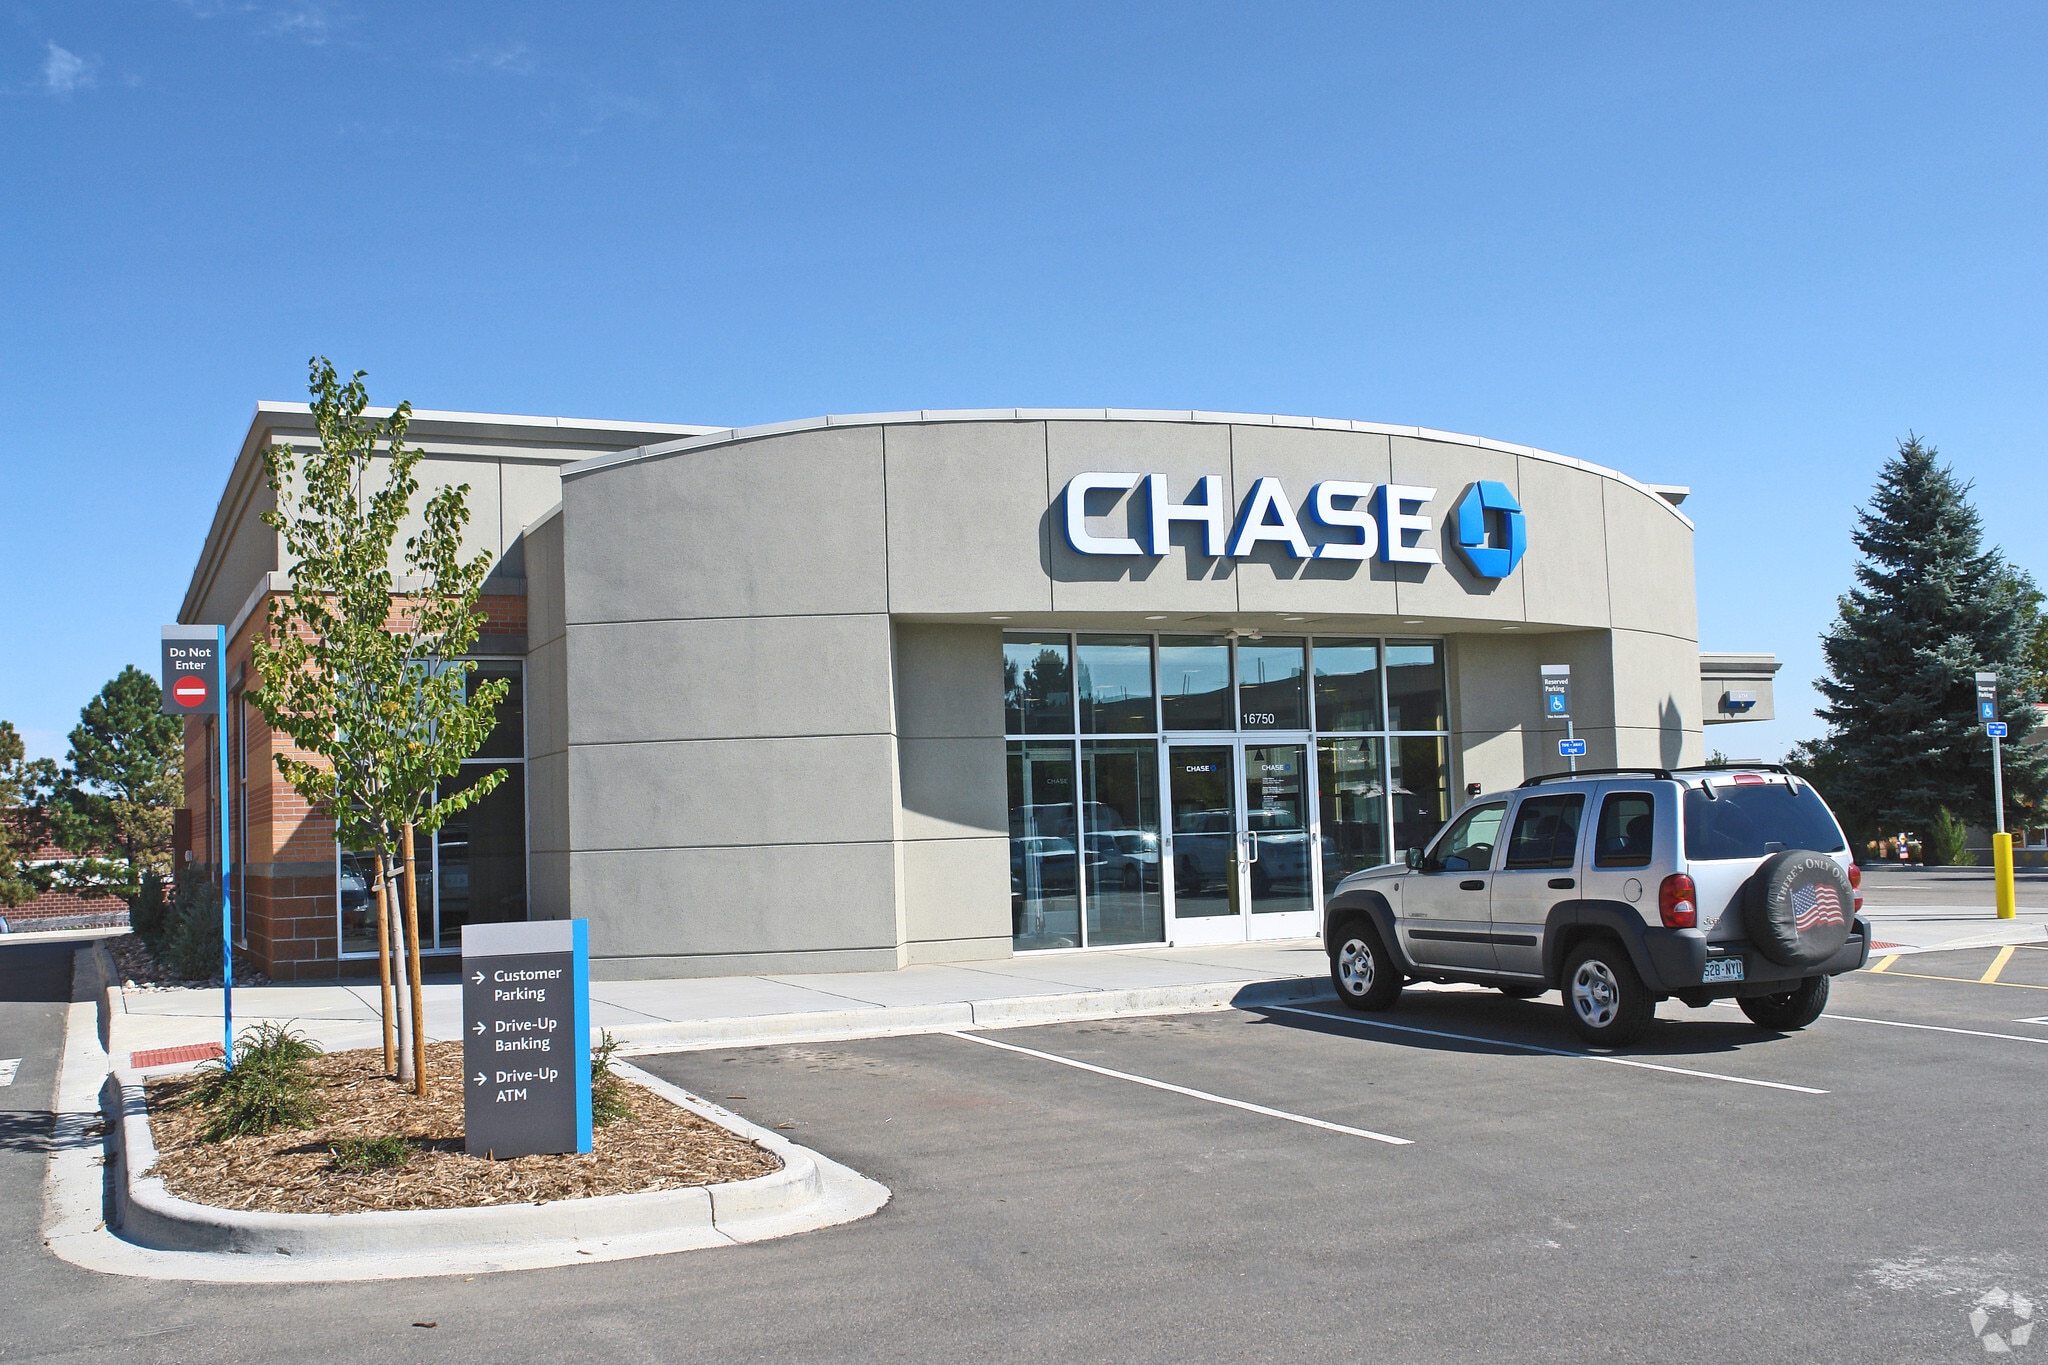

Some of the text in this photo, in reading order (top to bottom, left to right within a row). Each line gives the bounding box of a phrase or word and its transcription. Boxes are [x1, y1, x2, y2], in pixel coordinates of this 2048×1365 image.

[1064, 471, 1442, 565] CHASE
[169, 647, 211, 657] Do Not
[175, 660, 206, 670] Enter
[1545, 685, 1565, 693] Parking
[1243, 713, 1275, 724] 16750
[1777, 863, 1804, 902] THERE'S
[1805, 858, 1831, 872] ONLY
[494, 968, 562, 983] Customer
[494, 987, 546, 1002] Parking
[495, 1017, 557, 1034] Drive-Up
[495, 1037, 551, 1052] Banking
[496, 1067, 559, 1085] Drive-Up
[496, 1088, 527, 1103] ATM
